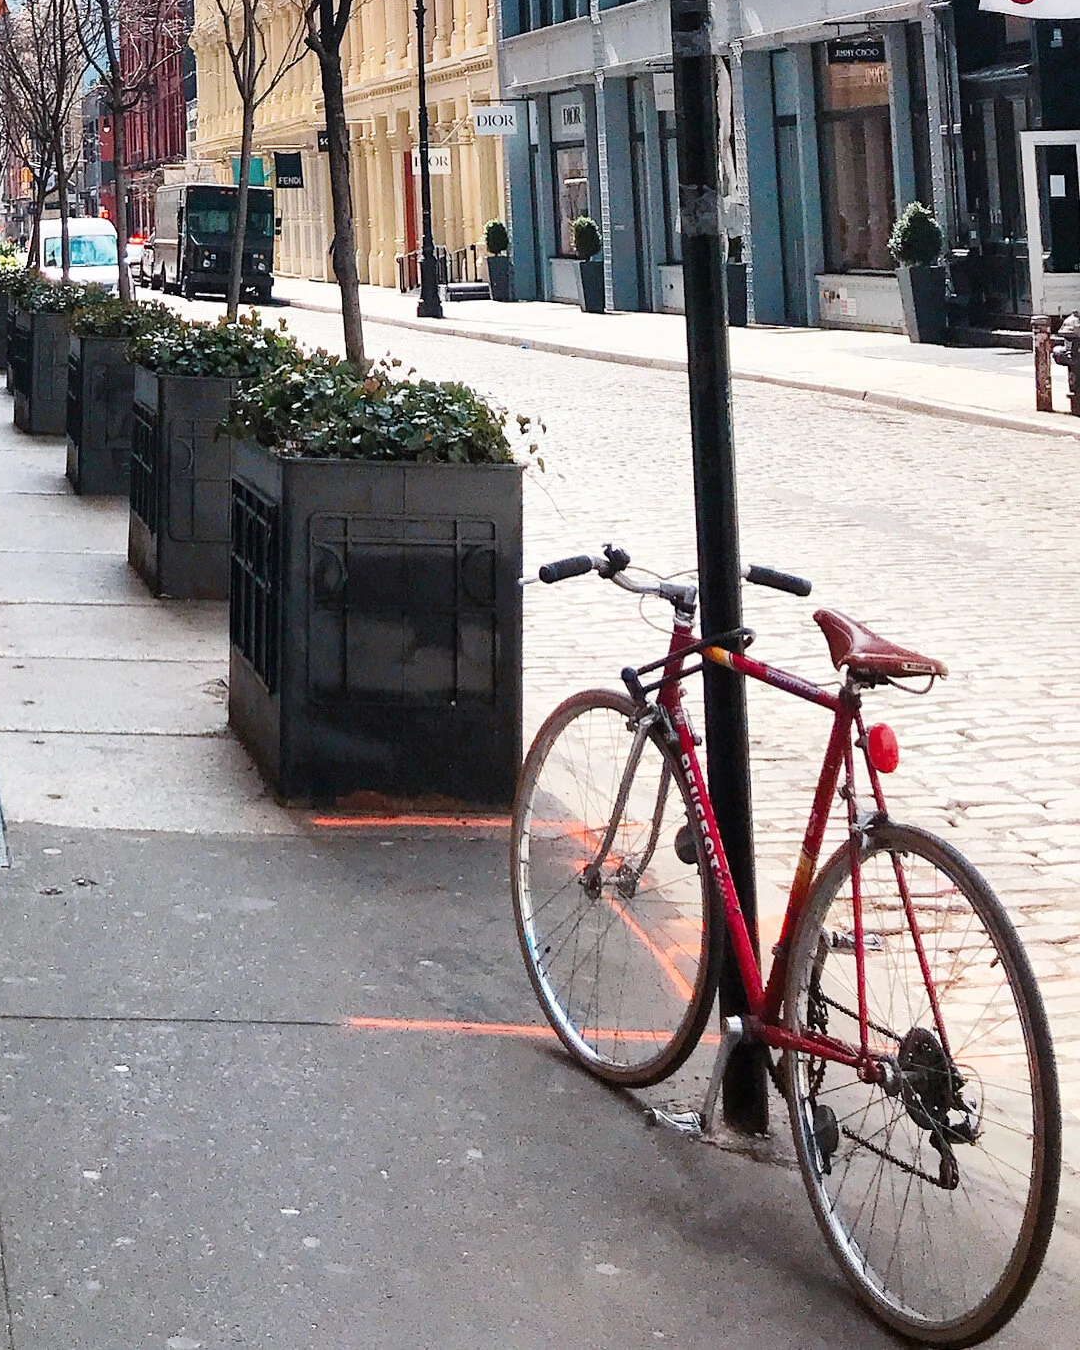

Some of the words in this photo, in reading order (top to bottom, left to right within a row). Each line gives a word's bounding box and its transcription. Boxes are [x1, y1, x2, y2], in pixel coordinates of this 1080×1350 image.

[855, 48, 879, 57] CHOO
[477, 114, 514, 127] DIOR
[563, 106, 582, 126] DIOR
[414, 155, 449, 167] OR
[278, 176, 301, 185] FENDI
